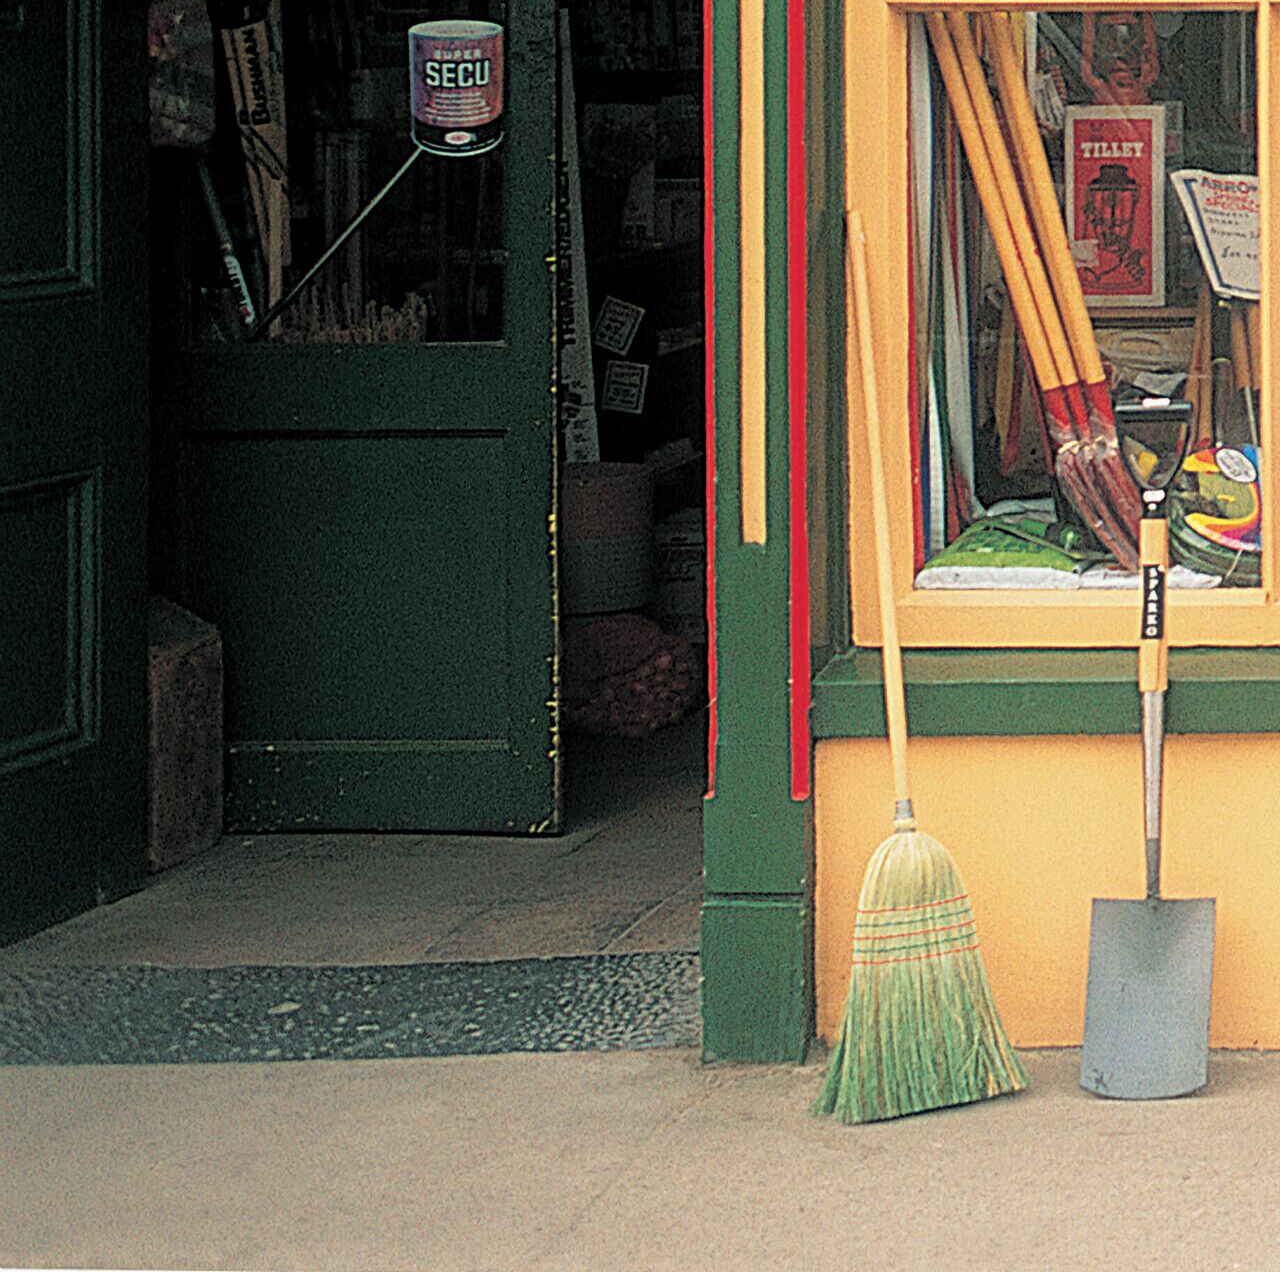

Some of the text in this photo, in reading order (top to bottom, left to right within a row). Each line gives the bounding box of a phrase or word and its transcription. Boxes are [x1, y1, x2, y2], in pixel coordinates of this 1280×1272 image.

[433, 48, 482, 59] SUPER
[424, 60, 490, 88] SECU
[1081, 141, 1144, 159] TILLEY
[1144, 566, 1160, 637] SPARKO
